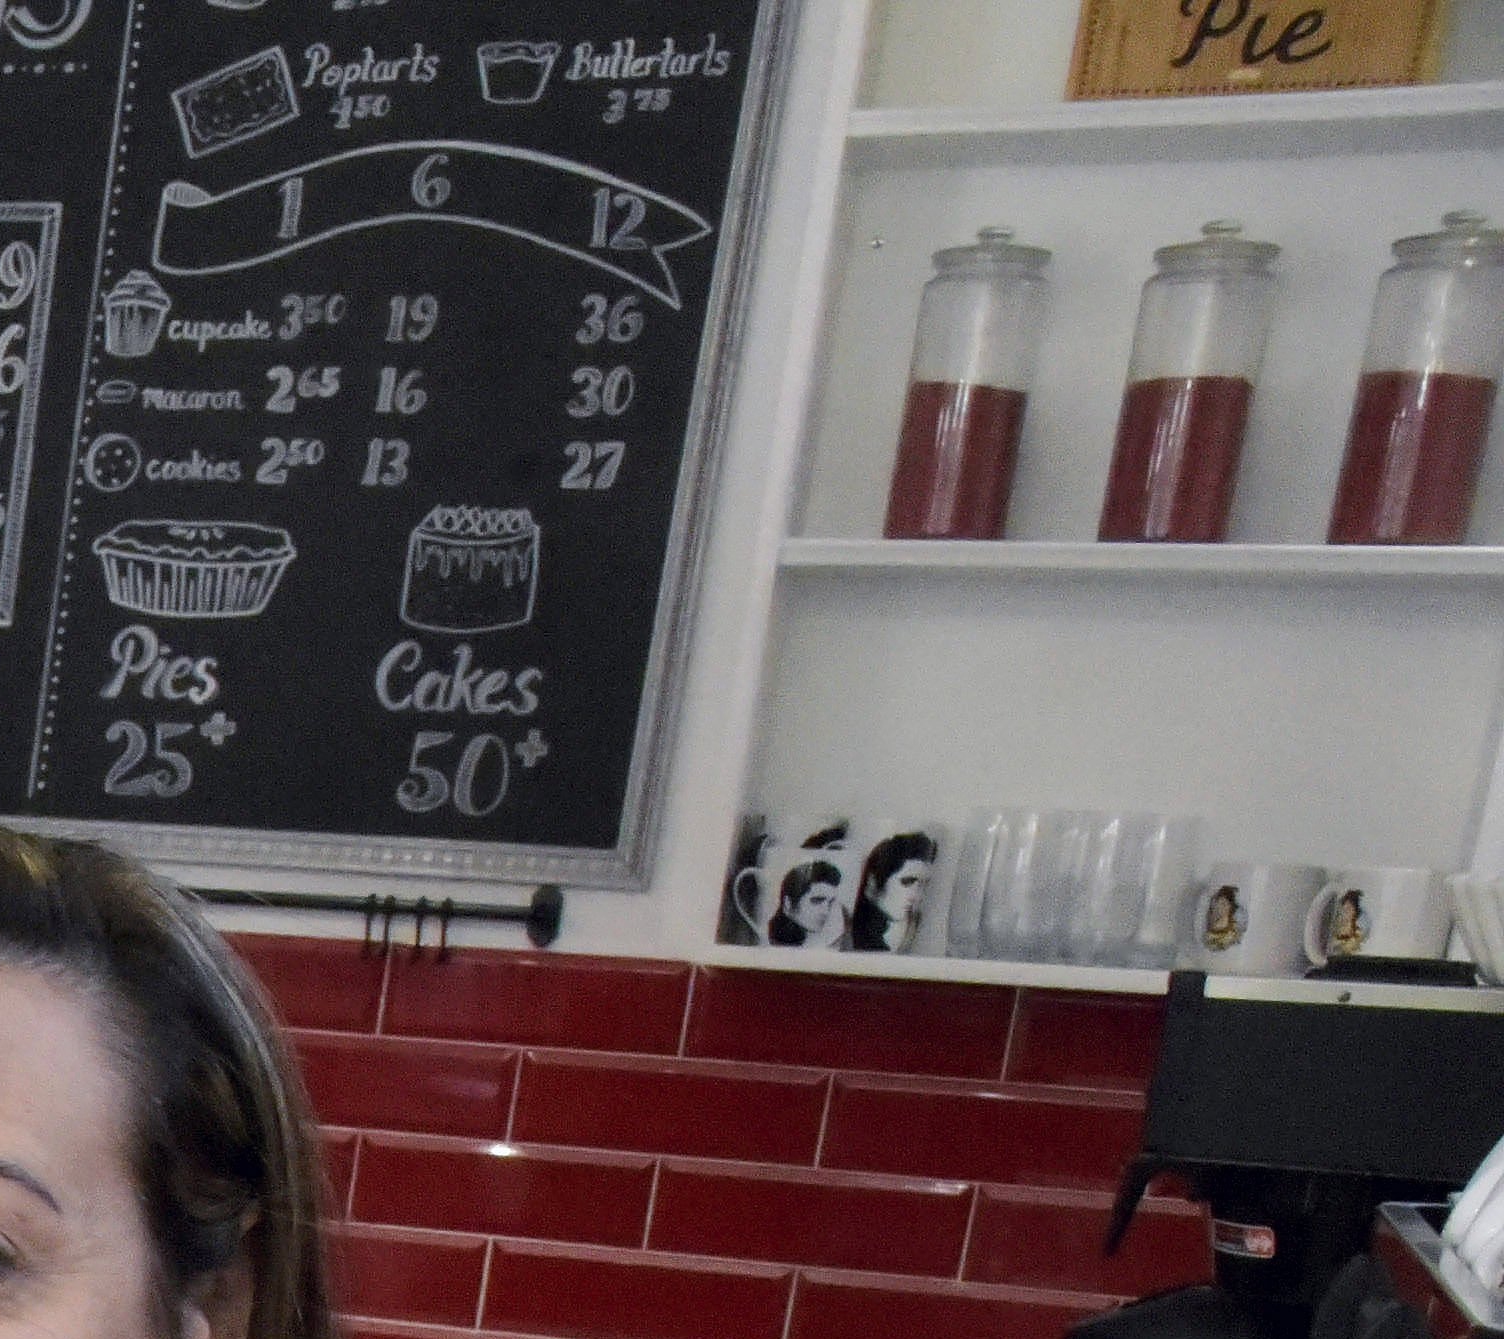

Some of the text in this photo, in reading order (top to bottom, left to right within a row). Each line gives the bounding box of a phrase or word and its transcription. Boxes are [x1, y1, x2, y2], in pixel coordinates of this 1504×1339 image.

[565, 33, 732, 83] Buttertarts
[1169, 0, 1333, 69] Pie
[302, 41, 439, 98] Poptarts
[276, 153, 650, 251] 1 6 12
[167, 310, 272, 353] cupcake
[385, 294, 440, 342] 19
[575, 293, 646, 344] 36
[374, 366, 429, 415] 16
[565, 365, 637, 418] 30
[144, 448, 243, 484] cookies
[360, 437, 412, 487] 13
[560, 440, 627, 490] 27
[99, 623, 220, 706] Pies
[374, 638, 544, 716] Cakes
